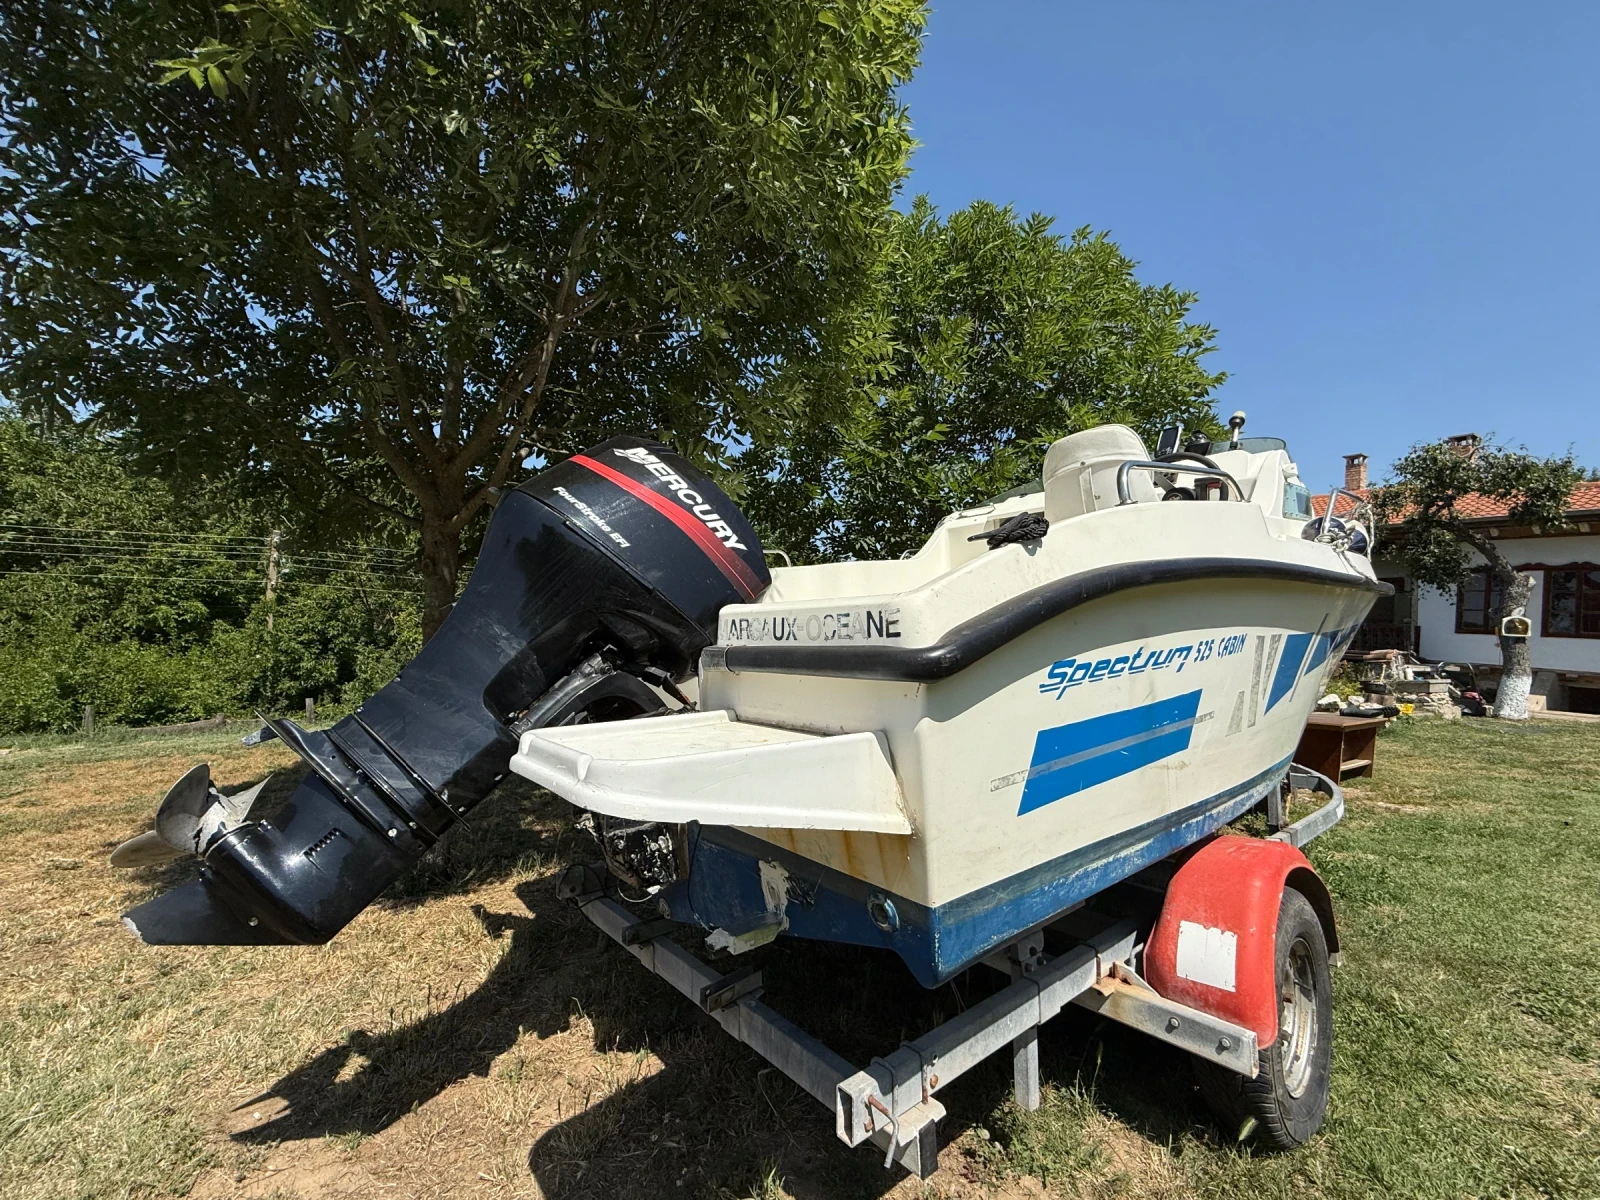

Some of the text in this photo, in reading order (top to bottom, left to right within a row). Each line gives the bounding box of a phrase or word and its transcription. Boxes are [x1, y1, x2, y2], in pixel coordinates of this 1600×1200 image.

[552, 486, 631, 548] FourStroke EFI
[613, 447, 748, 550] MERCURY
[1039, 633, 1248, 700] Spectrum 525 CABIN
